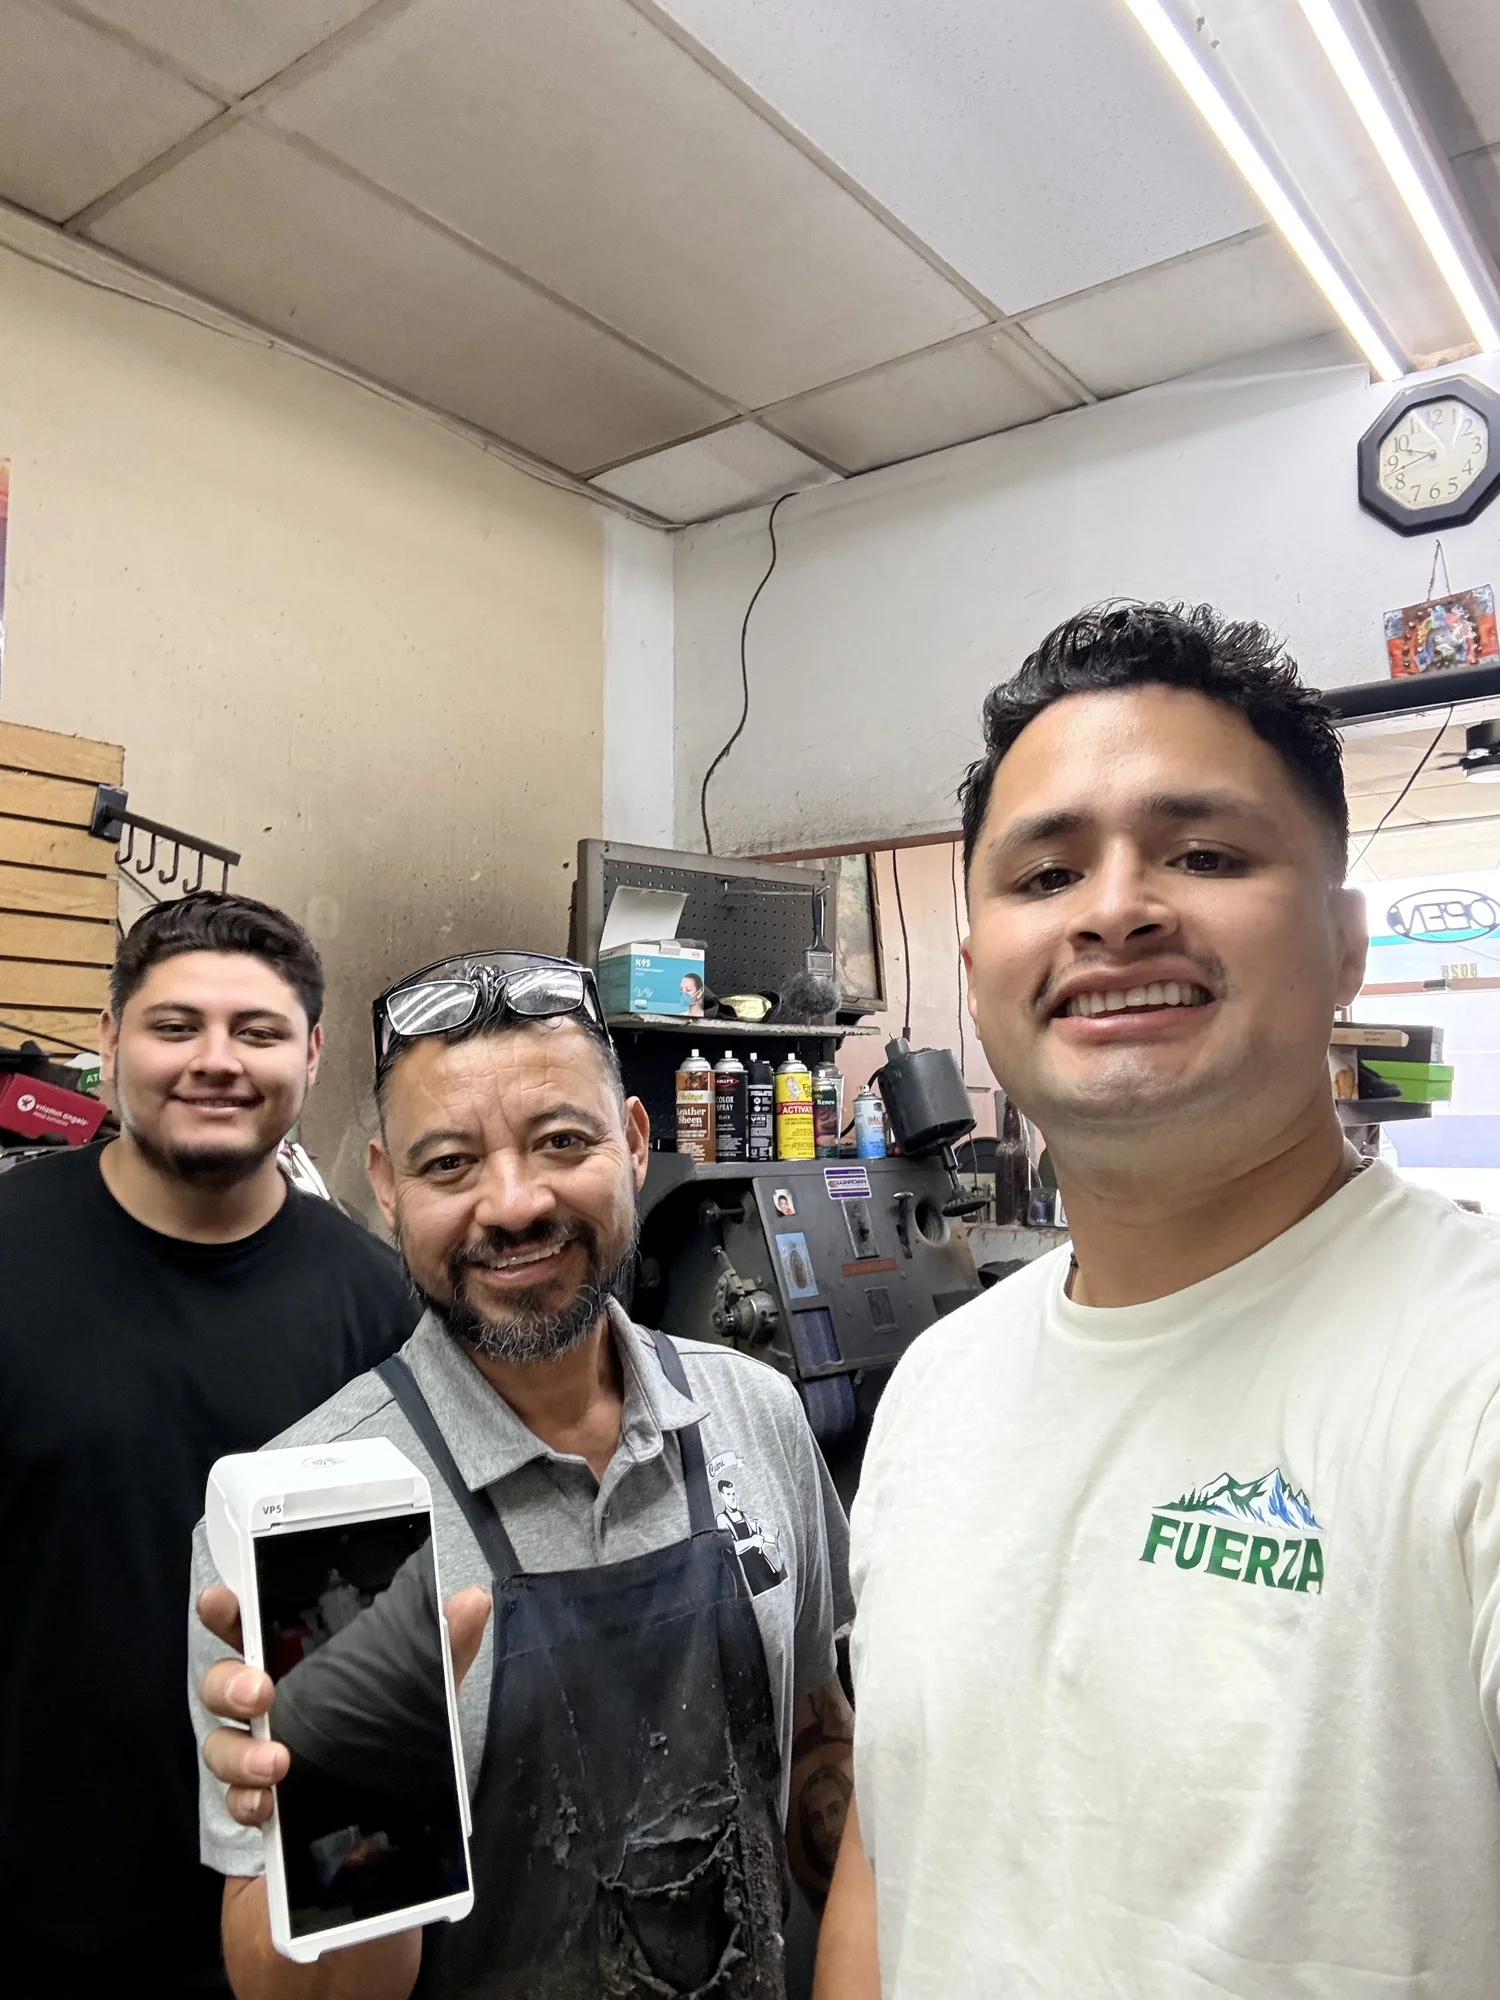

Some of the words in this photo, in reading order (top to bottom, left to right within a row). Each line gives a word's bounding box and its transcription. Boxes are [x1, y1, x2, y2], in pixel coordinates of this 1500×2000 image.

[1426, 408, 1443, 425] 12
[1451, 408, 1457, 425] 1
[1409, 417, 1422, 434] 11
[1462, 418, 1475, 436] 2
[1393, 434, 1410, 453] 10
[1471, 436, 1482, 454] 3
[1387, 455, 1399, 472] 9
[1461, 458, 1474, 475] 4
[1394, 472, 1406, 490] 8
[1447, 476, 1459, 495] 5
[1410, 484, 1422, 502] 7
[1429, 481, 1441, 499] 6
[86, 1073, 101, 1083] AT
[676, 1107, 706, 1116] Leather
[678, 1115, 702, 1124] Sheen
[1138, 1512, 1325, 1595] FUERZA
